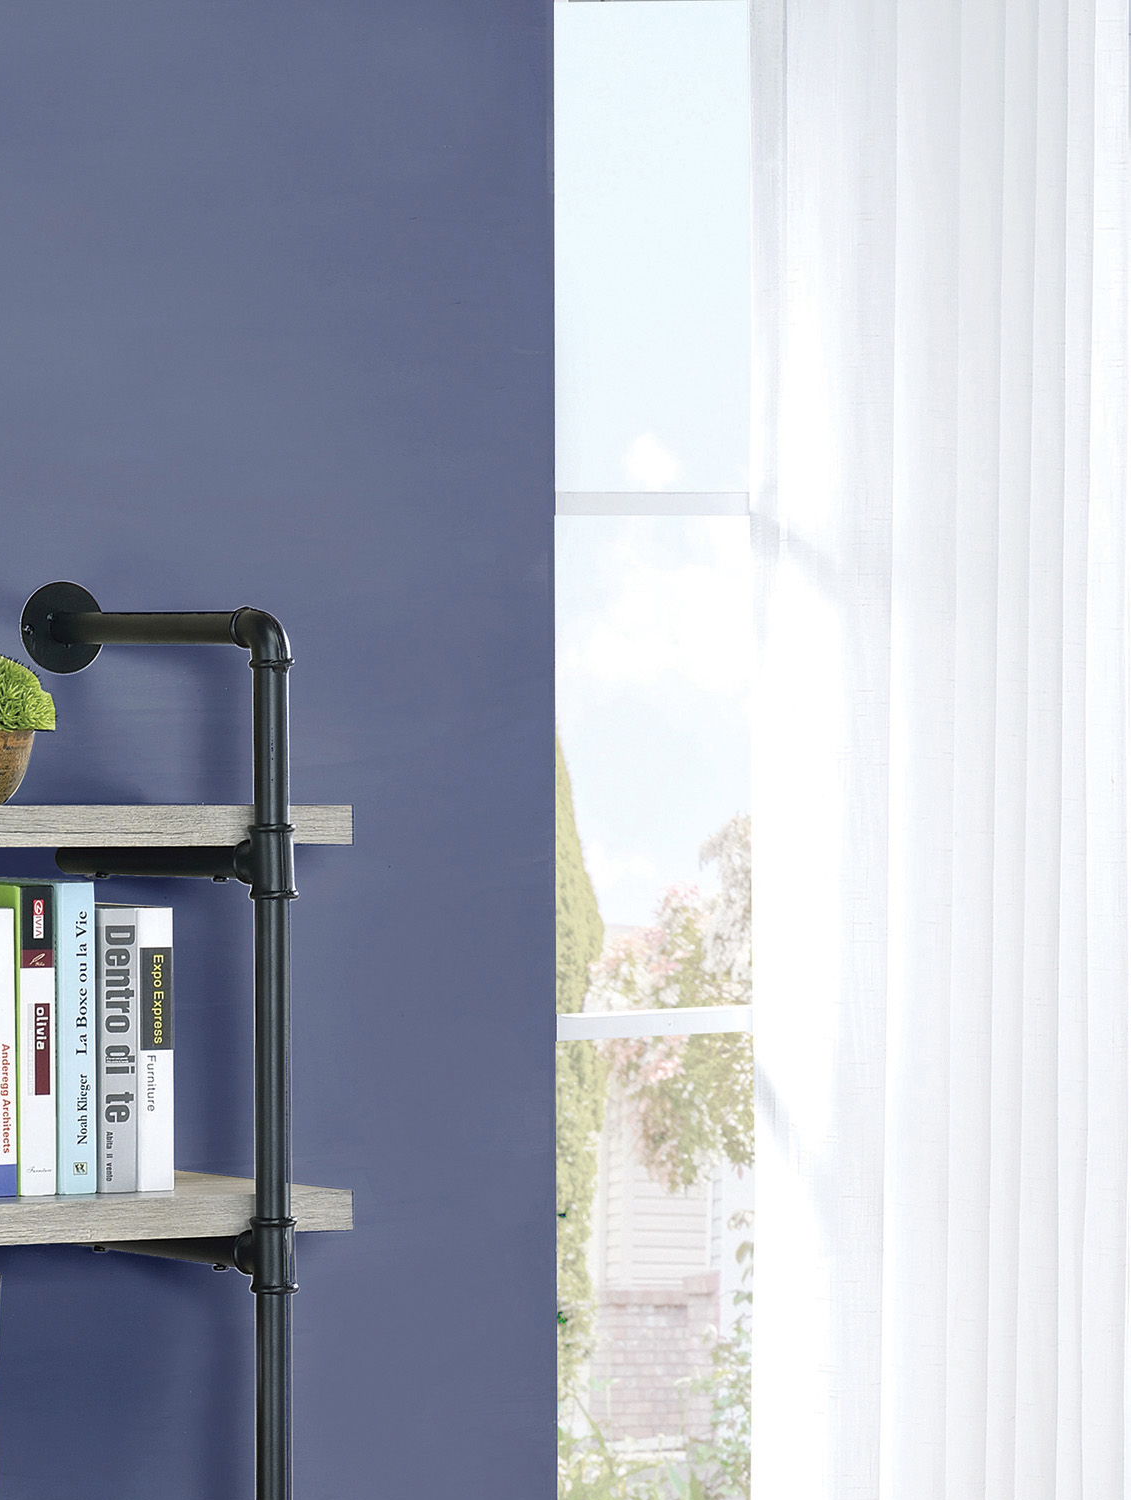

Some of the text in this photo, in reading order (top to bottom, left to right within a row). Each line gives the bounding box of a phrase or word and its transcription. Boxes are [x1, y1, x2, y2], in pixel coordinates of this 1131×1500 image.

[76, 911, 88, 1055] La Boxe ou la Vie
[105, 925, 136, 1034] Dentro
[151, 954, 164, 1044] Expo Express
[36, 1006, 48, 1050] olivia
[105, 1045, 135, 1074] di
[0, 1044, 12, 1154] Anderegg Architects
[77, 1074, 90, 1145] Noah Klieger
[105, 1092, 134, 1123] te
[146, 1055, 156, 1112] Furniture
